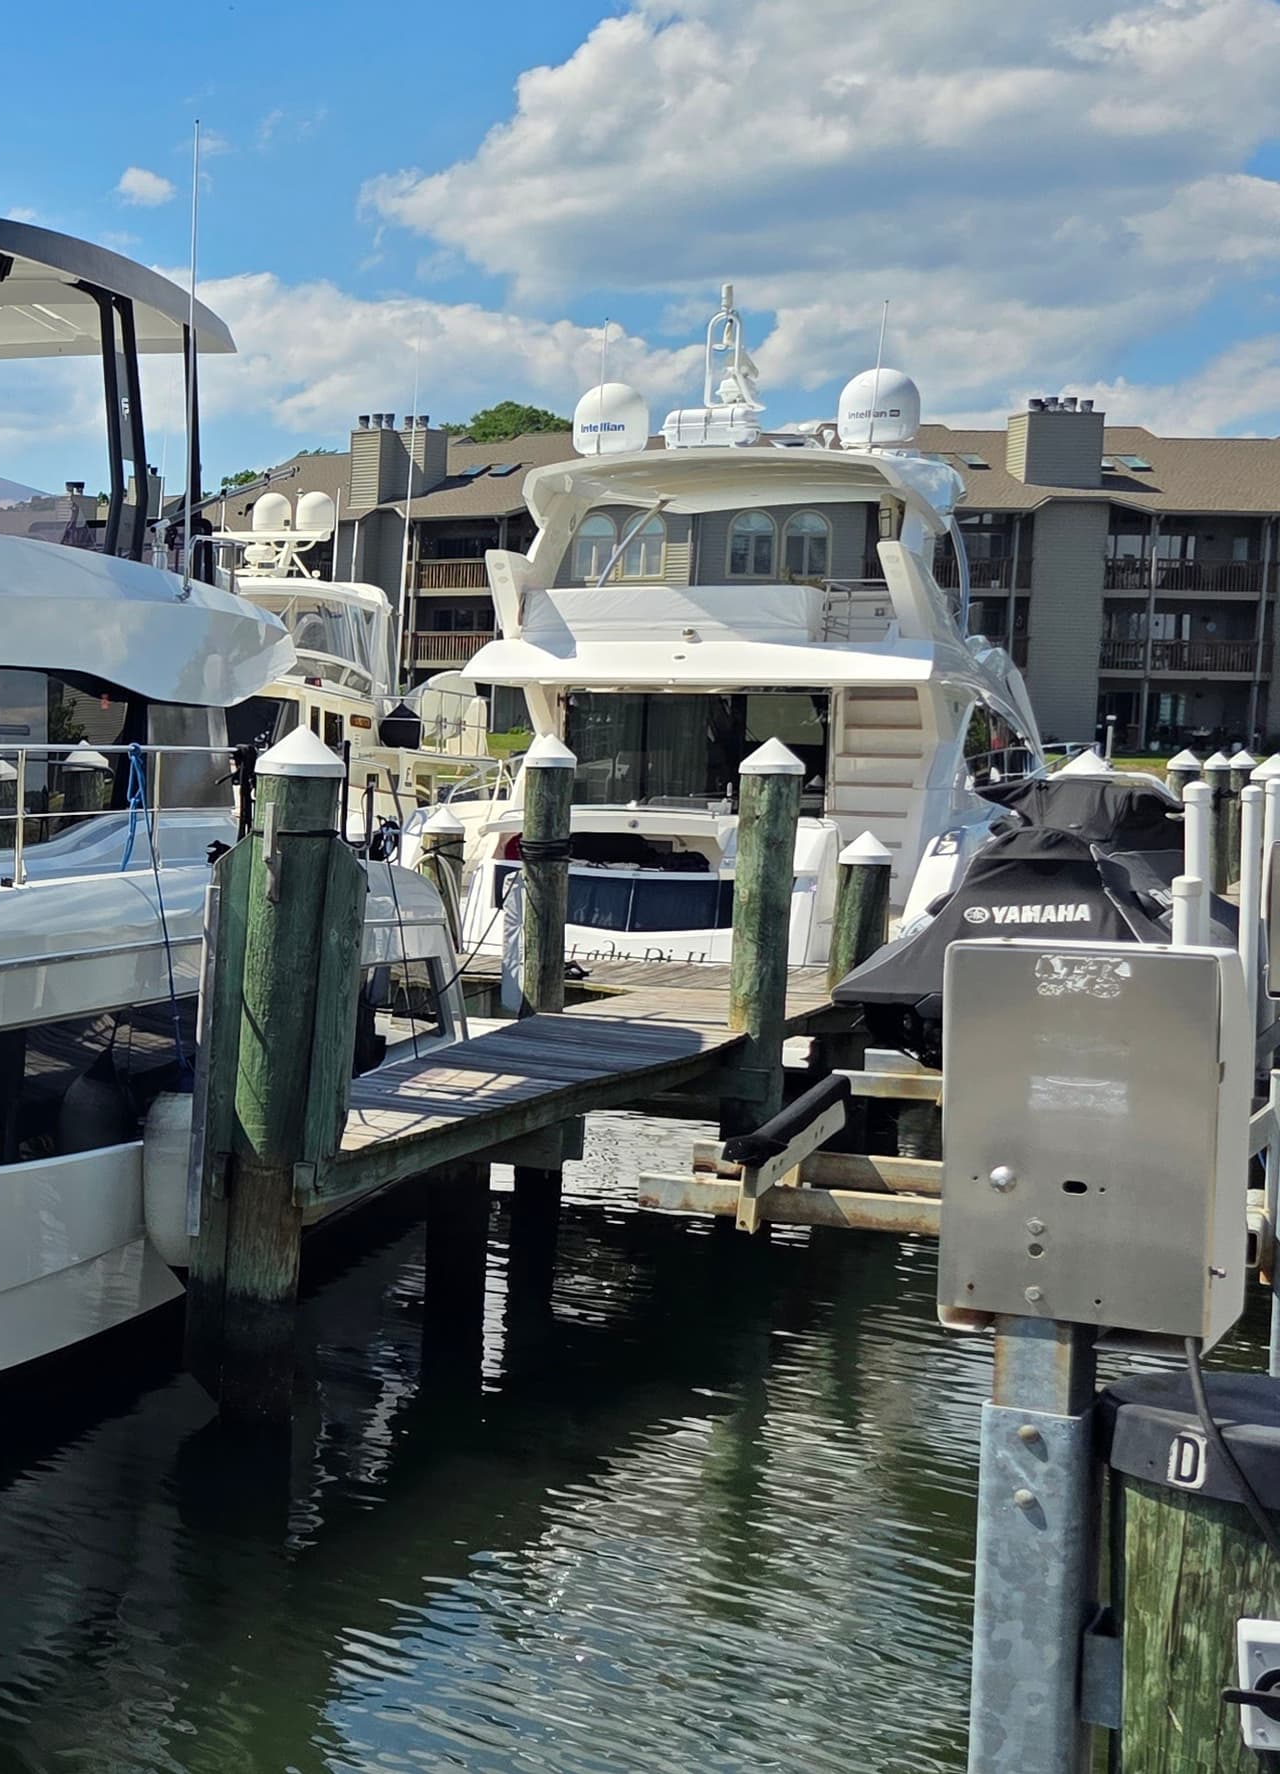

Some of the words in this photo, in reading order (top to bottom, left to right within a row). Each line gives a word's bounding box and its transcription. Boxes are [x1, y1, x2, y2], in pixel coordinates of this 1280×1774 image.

[847, 409, 887, 420] Intellan
[991, 904, 1092, 924] YAMAHA
[1174, 1434, 1200, 1483] D
